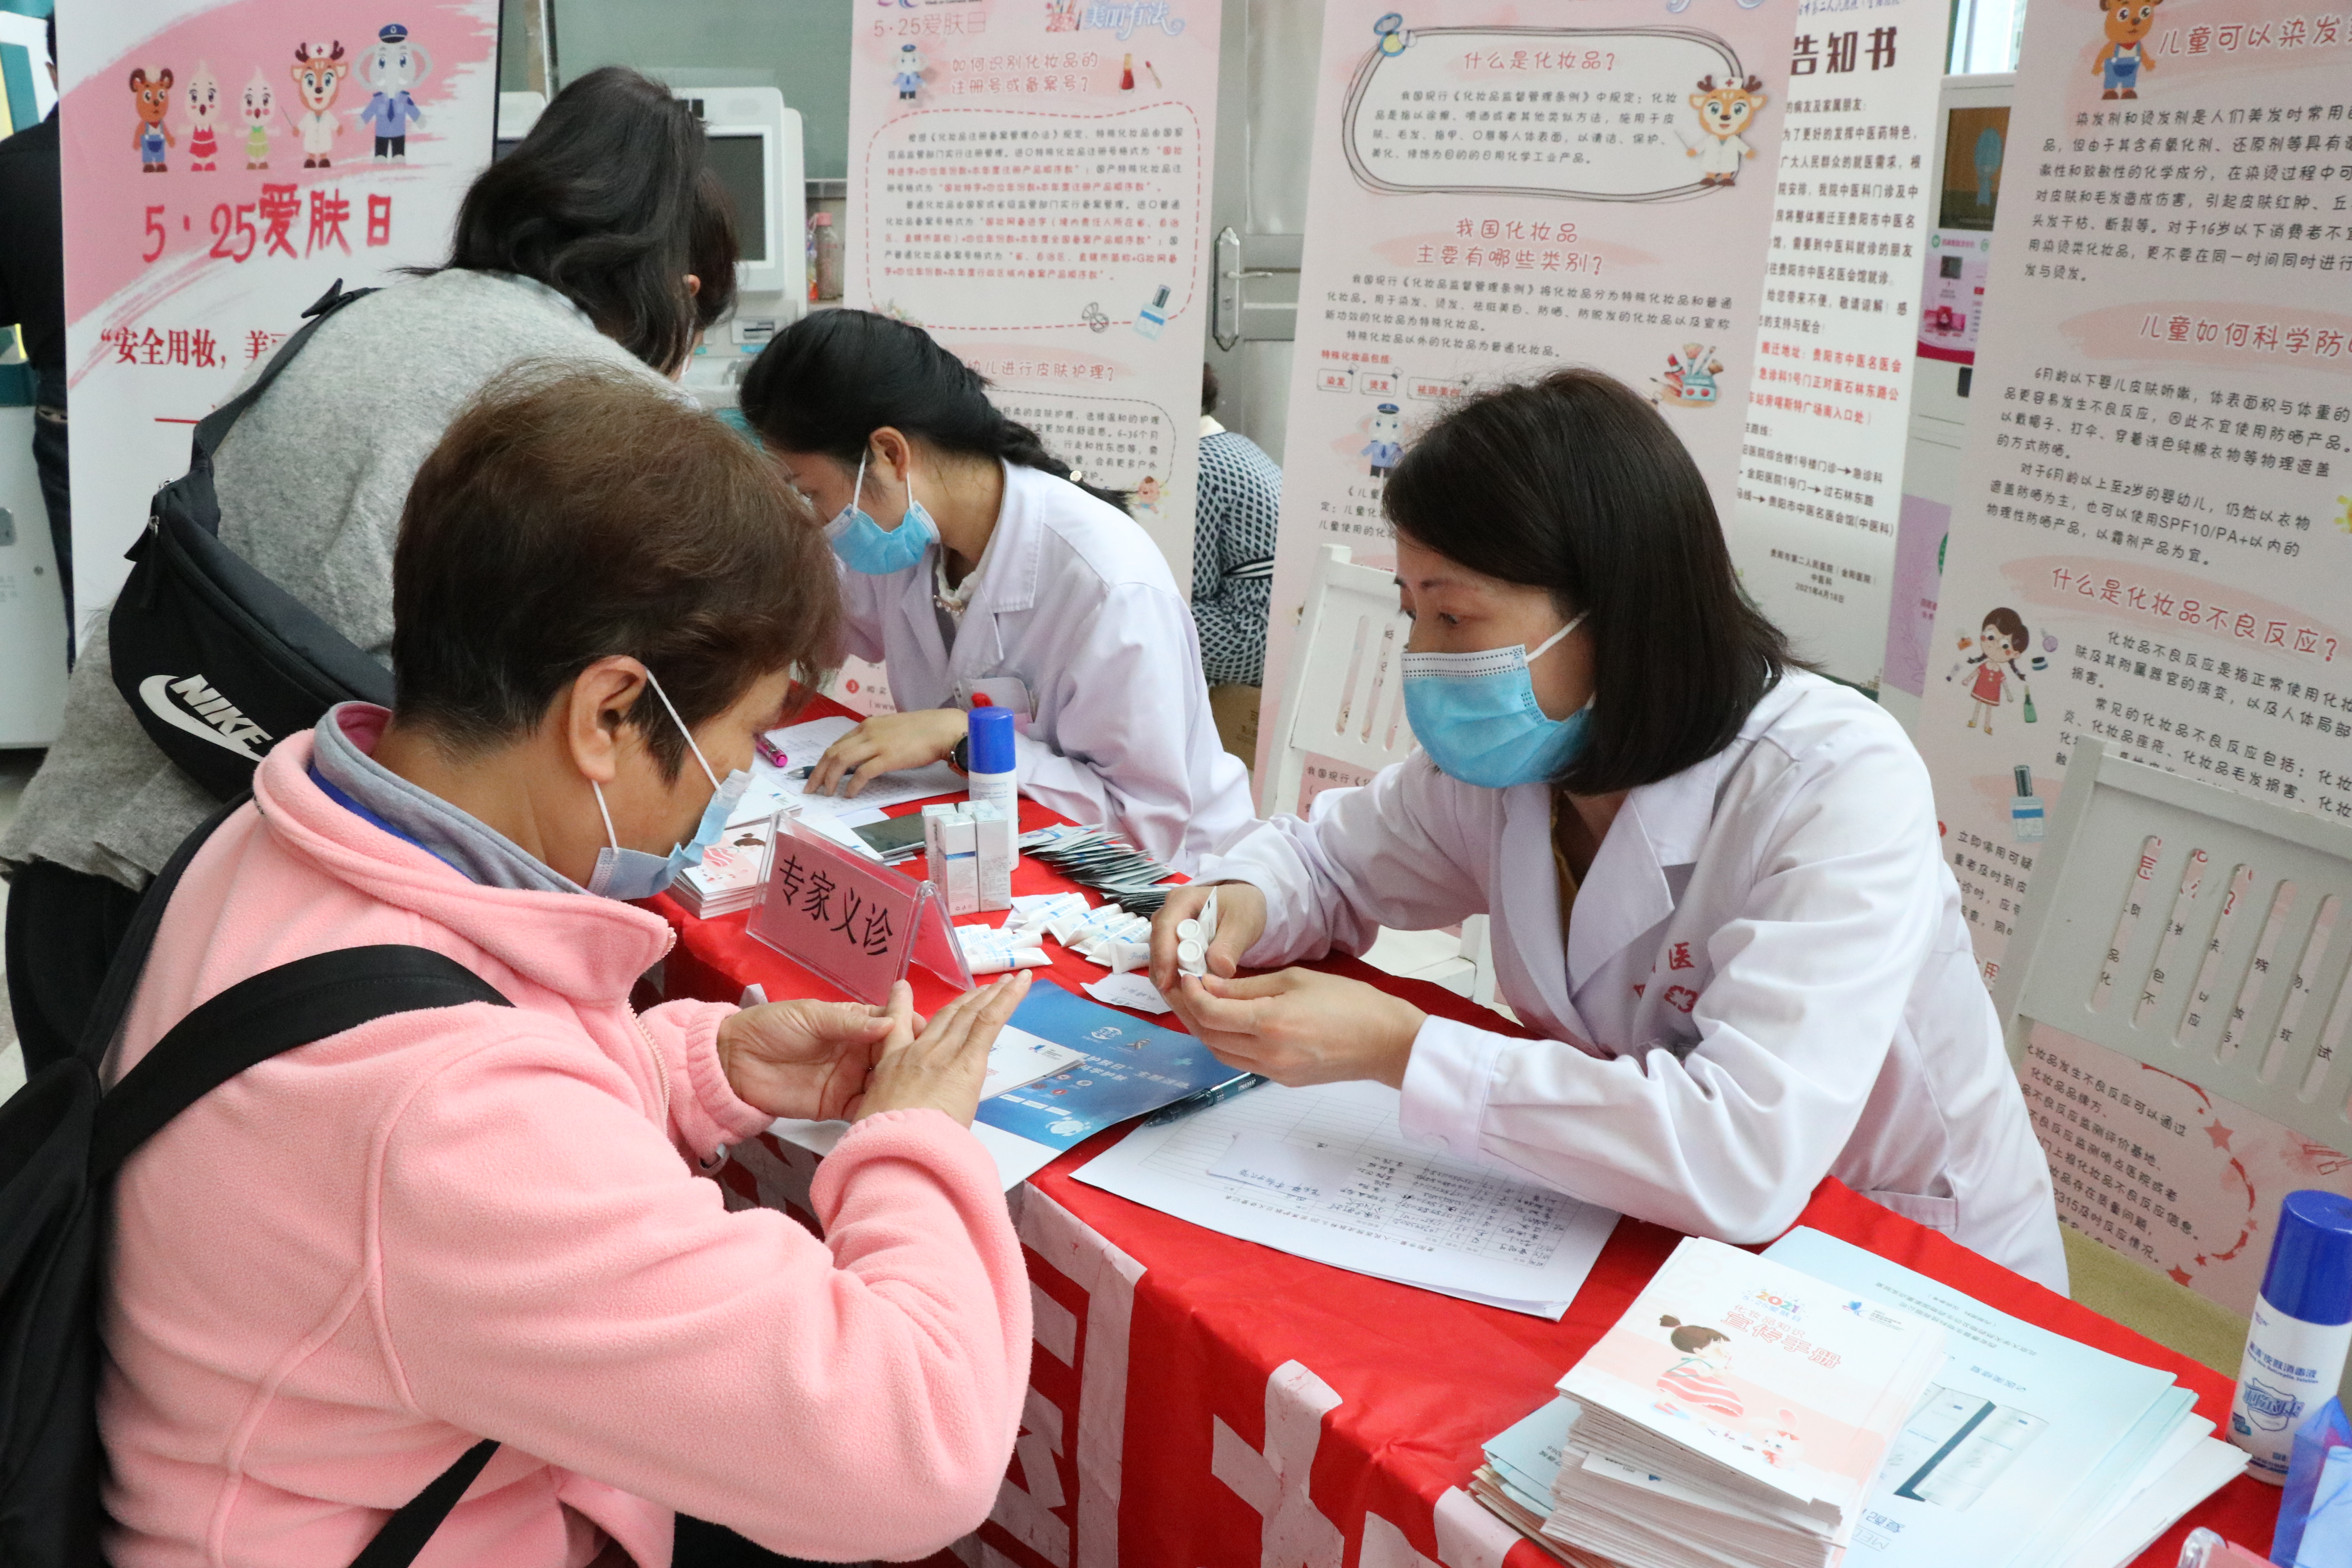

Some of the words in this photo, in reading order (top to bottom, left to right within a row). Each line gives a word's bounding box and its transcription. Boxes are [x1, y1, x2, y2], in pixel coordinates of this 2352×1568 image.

[1790, 26, 1897, 75] 告知书
[2159, 15, 2352, 55] 儿童可以染发
[953, 51, 1098, 73] 如何识别化妆品的
[1464, 50, 1617, 73] 什么是化妆品？
[2076, 104, 2352, 126] 染发剂和烫发剂是人们美发时常用
[1456, 218, 1578, 243] 我国化妆品
[1416, 245, 1603, 276] 主要有哪些类别？
[2025, 263, 2087, 281] 发与烫发。
[1325, 309, 1486, 332] 新功效的化妆品为特殊化妆品。
[2140, 315, 2352, 357] 儿童如何科学防
[101, 327, 287, 370] “安全用妆，美
[1997, 433, 2072, 460] 的方式防晒。
[2020, 463, 2310, 531] 对于6月龄以上至2岁的婴幼儿，仍然以衣物
[1986, 503, 2210, 566] 物理性防晒产品，以霜剂产品为宜。
[1990, 479, 2300, 557] 遮盖防晒为主，也可以使用SPF10/PA+以内的
[2052, 567, 2338, 662] 什么是化妆品不良反应？
[2071, 666, 2105, 688] 损害。
[2075, 645, 2351, 738] 肤及其附属器官的病变，以及人体局部
[2108, 630, 2352, 713] 化妆品不良反应是指正常使用化妆
[169, 674, 274, 750] NIKE
[2096, 697, 2352, 791] 常见的化妆品不良反应包括：化妆
[1958, 830, 2033, 871] 立即停用可疑
[777, 853, 894, 957] 专家义诊
[1669, 942, 1695, 970] 医
[2031, 1067, 2107, 1118] 化妆品品牌方、
[1733, 1304, 1806, 1338] 化妆品知识
[1756, 1290, 1800, 1313] 2021
[1721, 1310, 1841, 1369] 宣传手册
